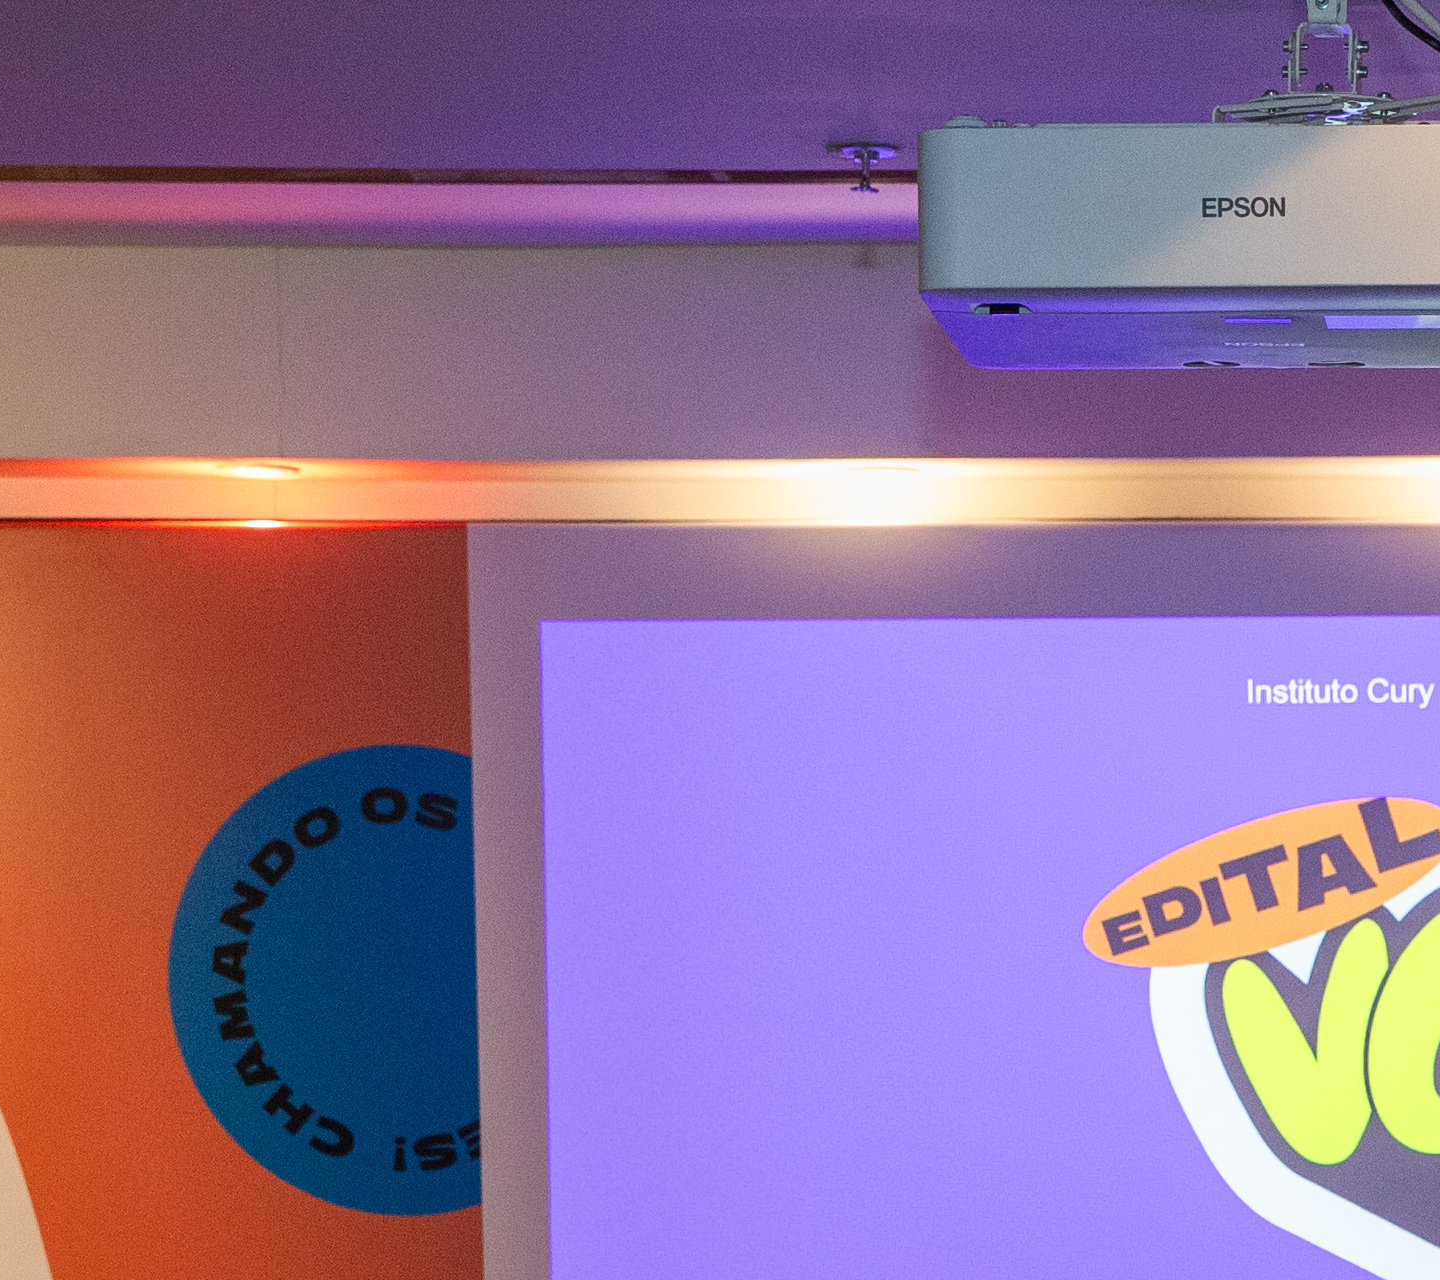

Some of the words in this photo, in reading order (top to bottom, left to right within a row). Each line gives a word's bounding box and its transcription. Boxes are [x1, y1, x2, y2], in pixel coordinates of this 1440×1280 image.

[1201, 196, 1286, 218] EPSON
[1247, 678, 1358, 704] Instituto
[1367, 678, 1435, 709] Cury
[212, 805, 356, 1159] CHAMANDO
[361, 787, 458, 831] OS
